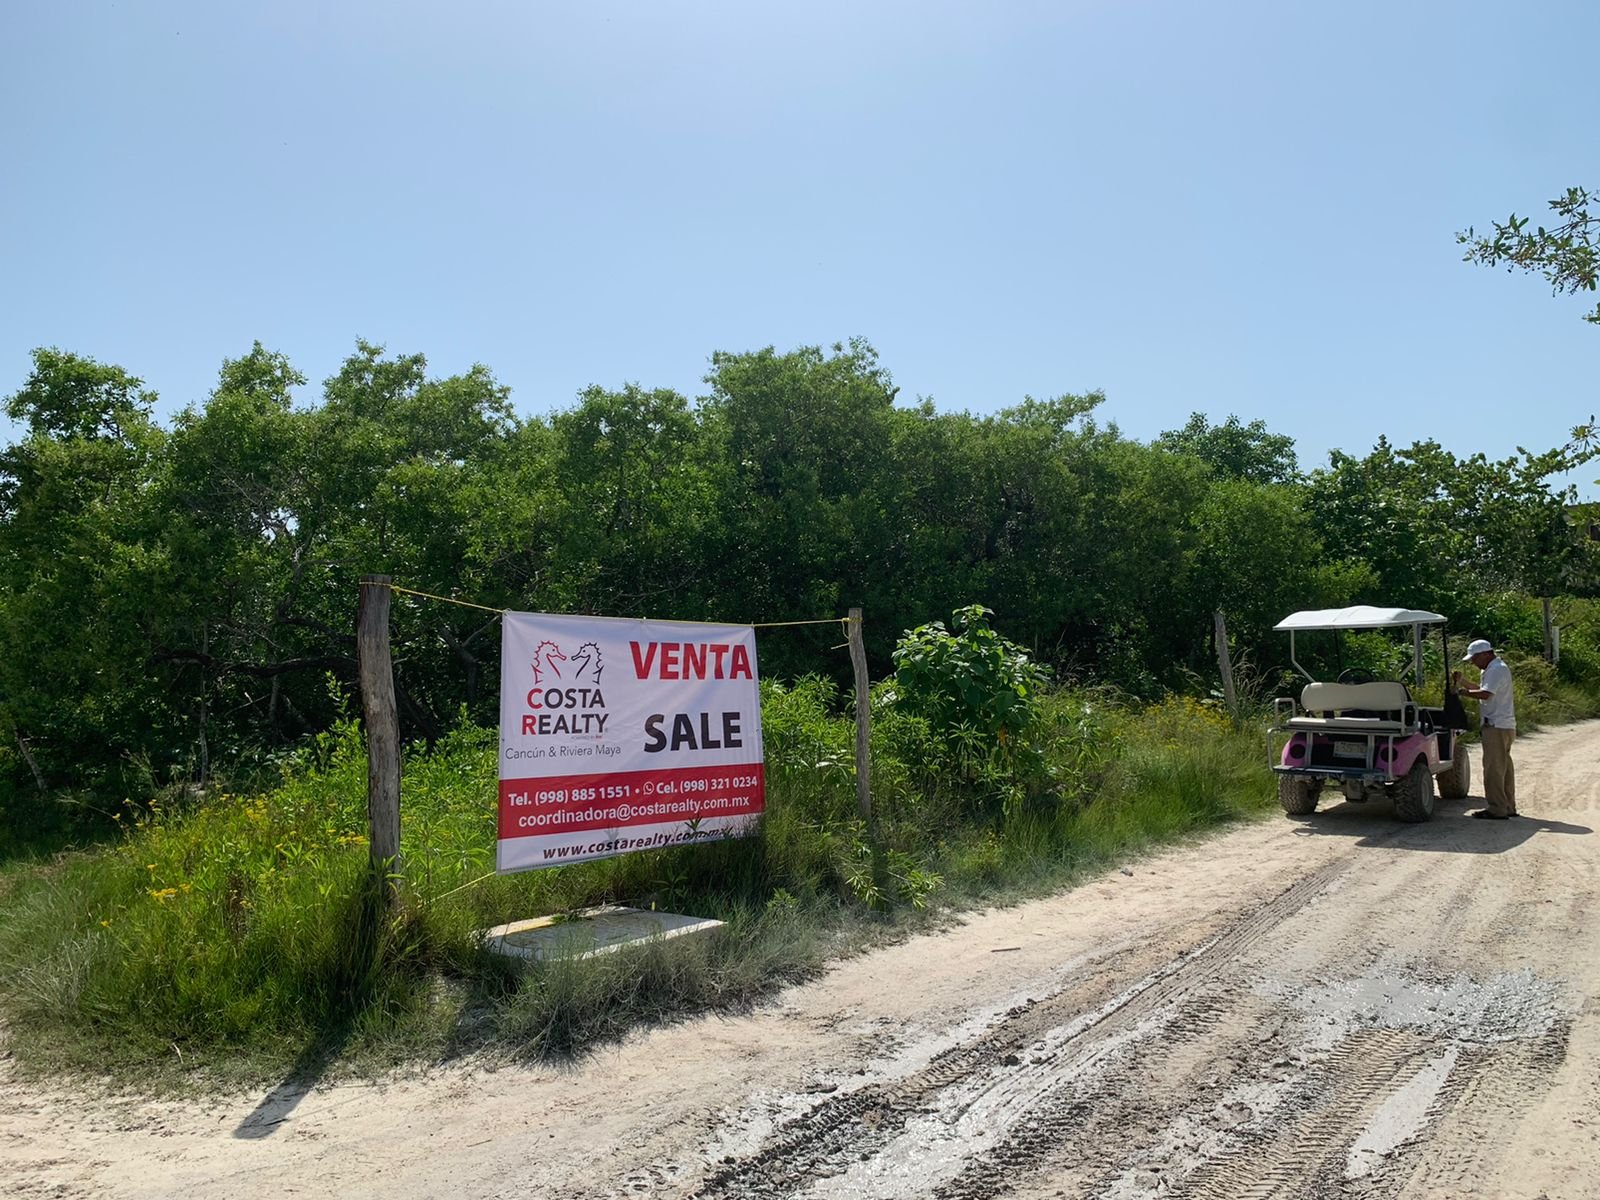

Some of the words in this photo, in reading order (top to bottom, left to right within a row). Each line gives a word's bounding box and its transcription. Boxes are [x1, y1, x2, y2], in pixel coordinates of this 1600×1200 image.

[629, 641, 753, 680] VENTA
[527, 688, 606, 710] COSTA
[522, 713, 609, 735] REALTY
[643, 712, 742, 753] SALE
[505, 747, 546, 760] Cancún
[548, 746, 557, 757] &
[560, 745, 593, 757] Riviera
[595, 744, 621, 757] Maya
[508, 792, 532, 806] Tel.
[535, 789, 569, 806] (998)
[571, 788, 596, 801] 885
[599, 785, 630, 799] 1551
[656, 781, 678, 794] Cel.
[680, 779, 709, 794] (998)
[711, 778, 730, 790] 321
[732, 776, 758, 788] 0234
[518, 796, 750, 828] coordinadora@costarealty.com.mx
